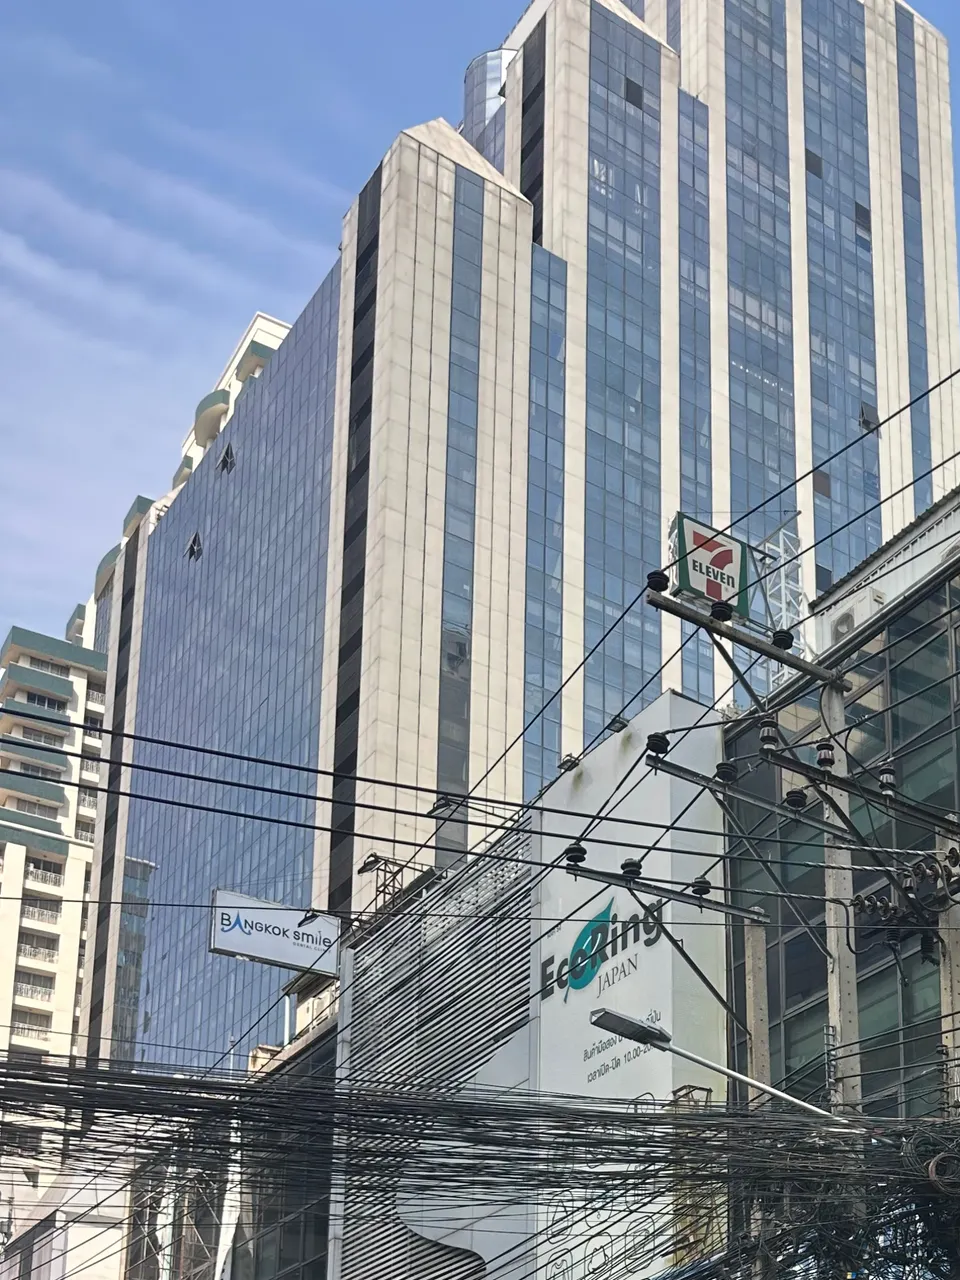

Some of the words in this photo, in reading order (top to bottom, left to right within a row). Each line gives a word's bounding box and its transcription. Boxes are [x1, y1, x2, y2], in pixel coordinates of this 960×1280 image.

[220, 909, 290, 938] BANGKOK
[292, 930, 332, 948] smile
[540, 897, 663, 1001] EcoRing
[596, 952, 639, 999] JAPAN
